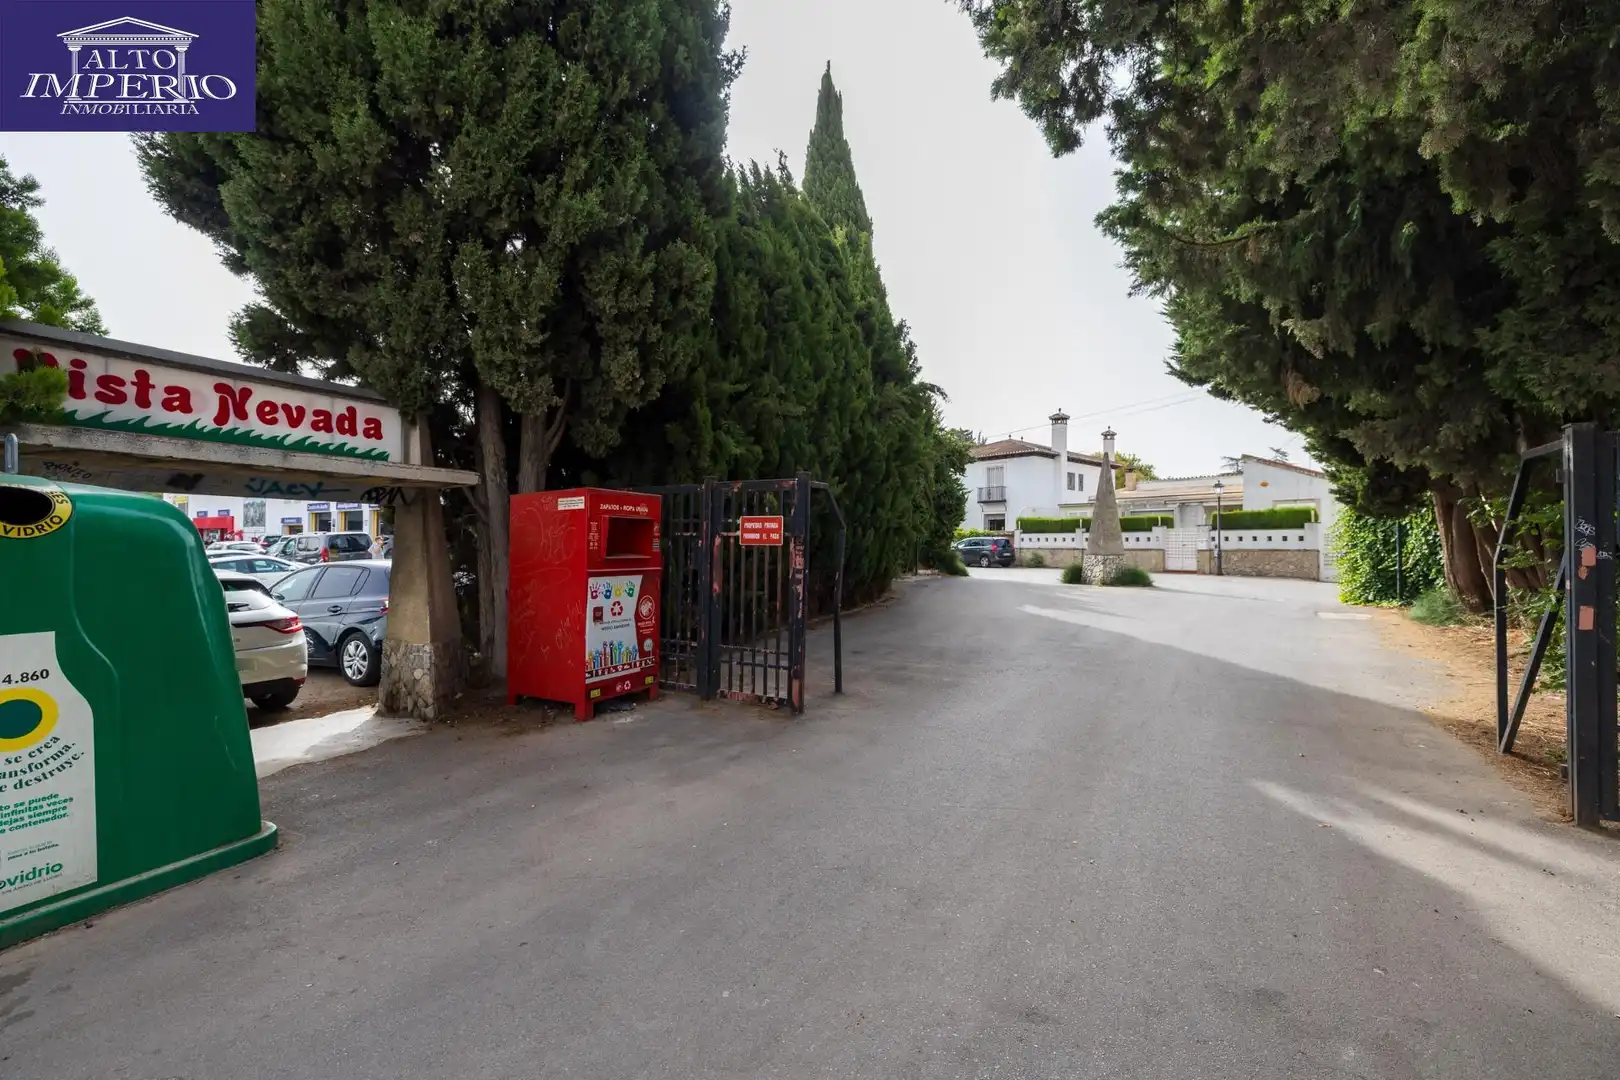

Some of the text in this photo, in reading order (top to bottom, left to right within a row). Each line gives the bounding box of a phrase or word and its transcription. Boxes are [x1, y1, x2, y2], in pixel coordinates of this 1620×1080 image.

[213, 382, 383, 441] Nevada
[3, 515, 63, 536] VIDRIO
[2, 669, 50, 685] 4.860
[4, 736, 61, 765] se crea
[0, 797, 73, 819] infinitas veces
[28, 793, 59, 806] puede
[28, 806, 67, 819] siempre
